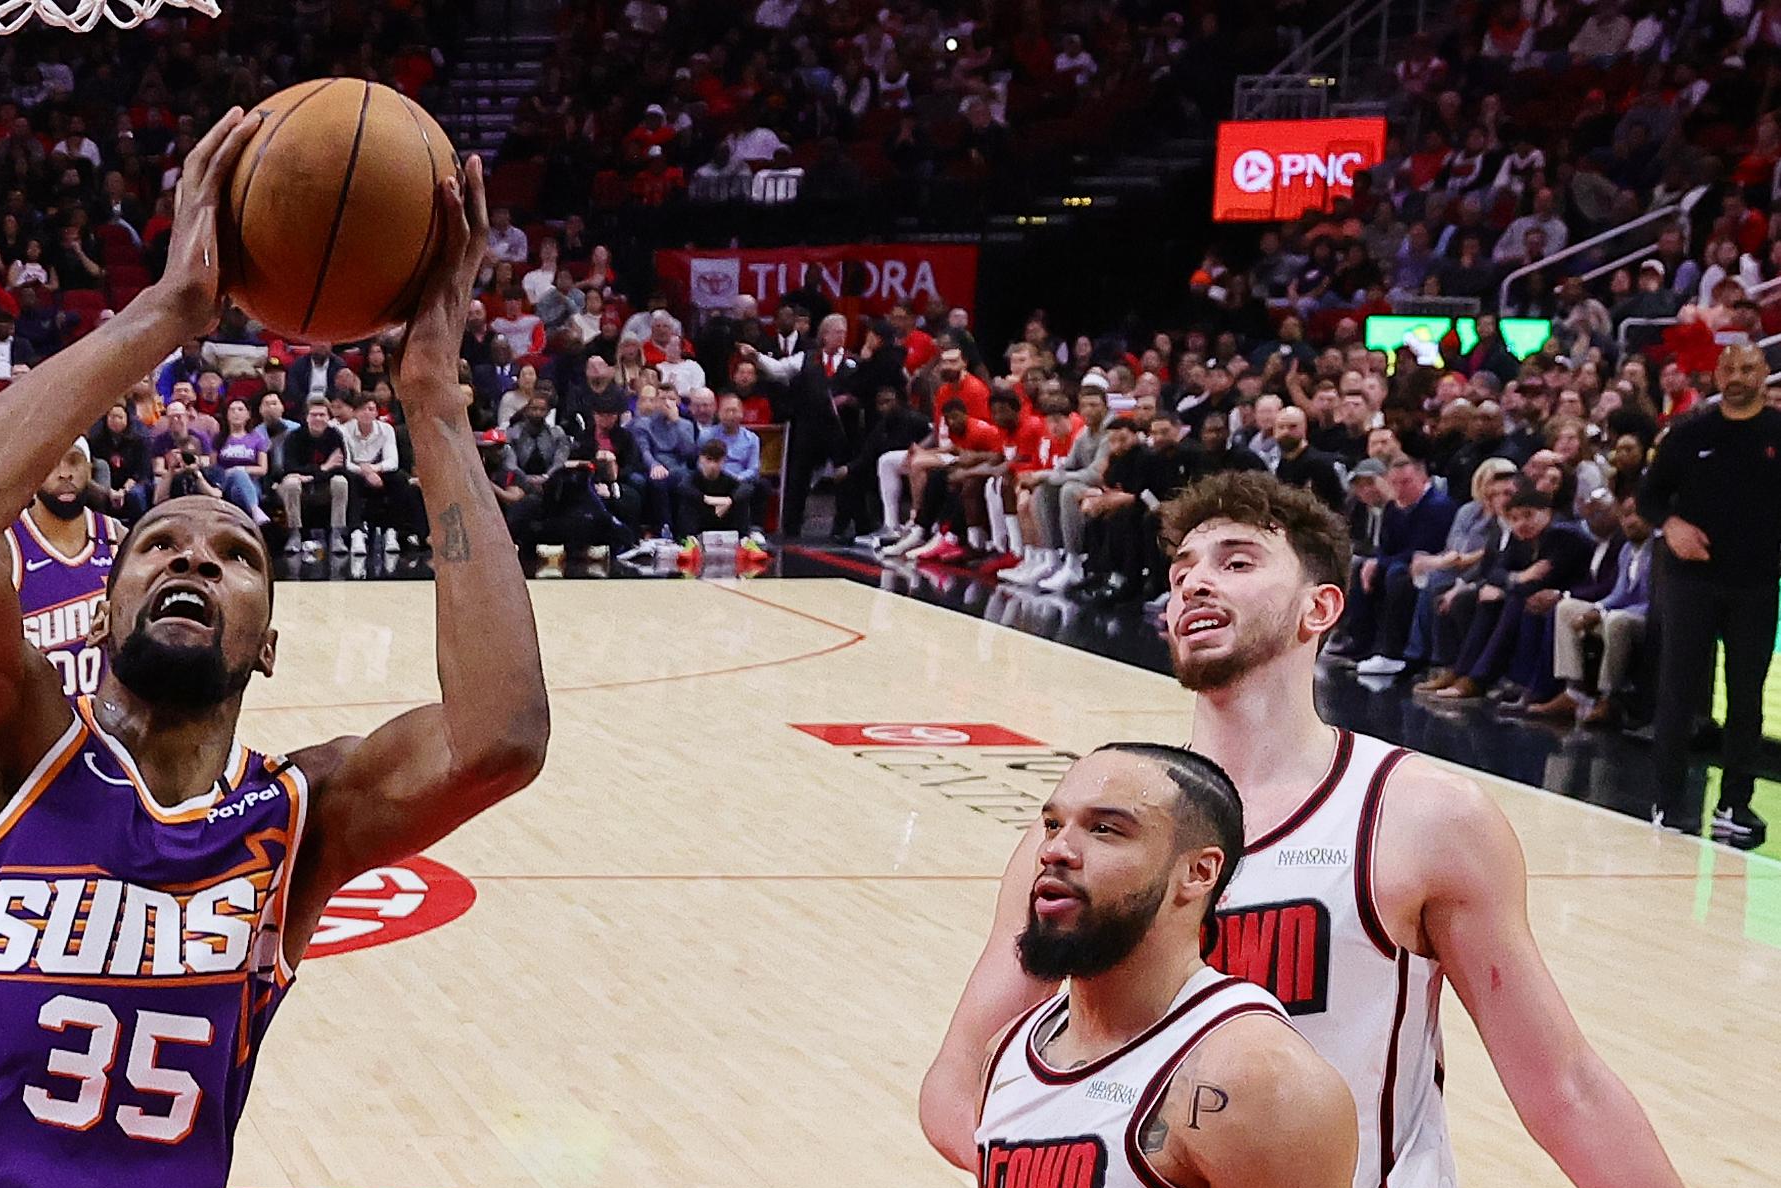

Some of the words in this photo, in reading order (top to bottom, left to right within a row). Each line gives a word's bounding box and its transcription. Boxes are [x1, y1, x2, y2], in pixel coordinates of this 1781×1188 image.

[1280, 152, 1363, 188] PNC
[206, 783, 280, 823] PayPal
[1278, 855, 1347, 866] HERMANN
[1279, 847, 1348, 860] MEMORIAL
[23, 995, 215, 1144] 35
[1086, 1088, 1136, 1105] HERMANN
[1090, 1080, 1139, 1098] MEMORIAL
[1187, 1082, 1229, 1130] P
